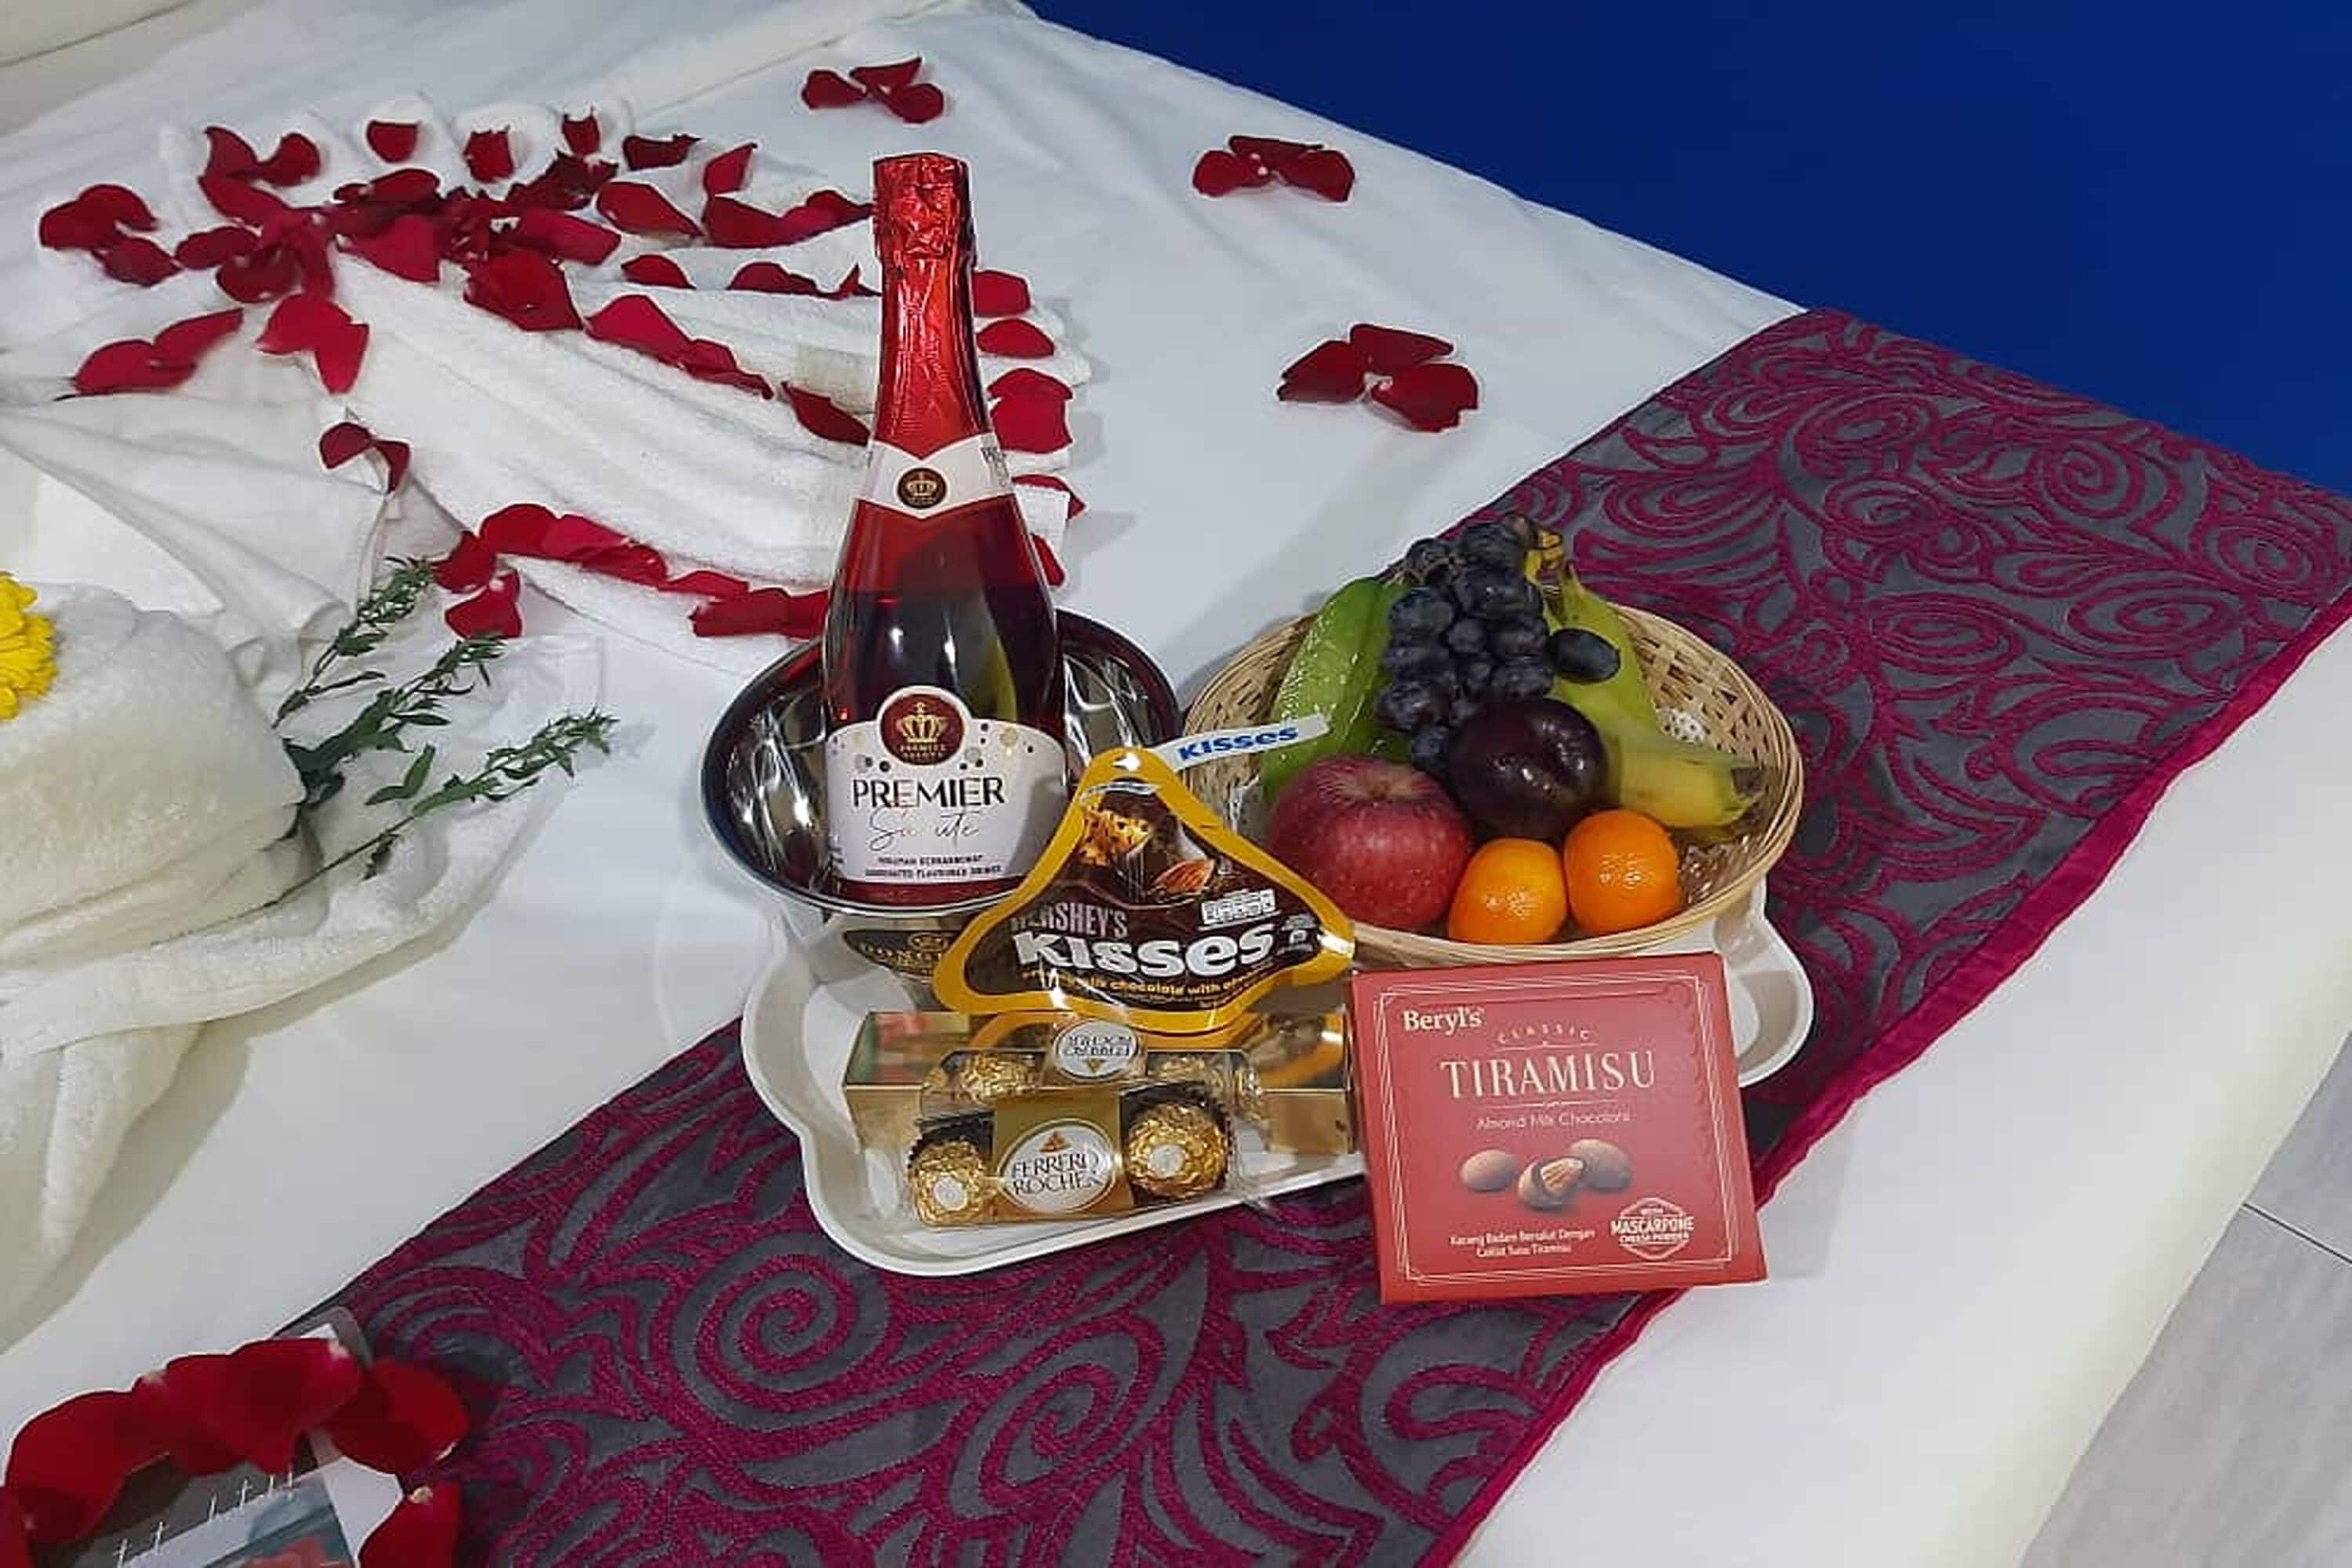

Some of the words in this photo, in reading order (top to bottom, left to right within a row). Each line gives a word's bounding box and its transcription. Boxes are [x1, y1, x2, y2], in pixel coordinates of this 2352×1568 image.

[853, 776, 1005, 808] PREMIER
[1403, 1007, 1485, 1036] Beryl's
[1439, 1050, 1655, 1099] TIRAMISU
[1011, 1149, 1101, 1178] FERRERO
[1610, 1216, 1694, 1236] MASCARPONE
